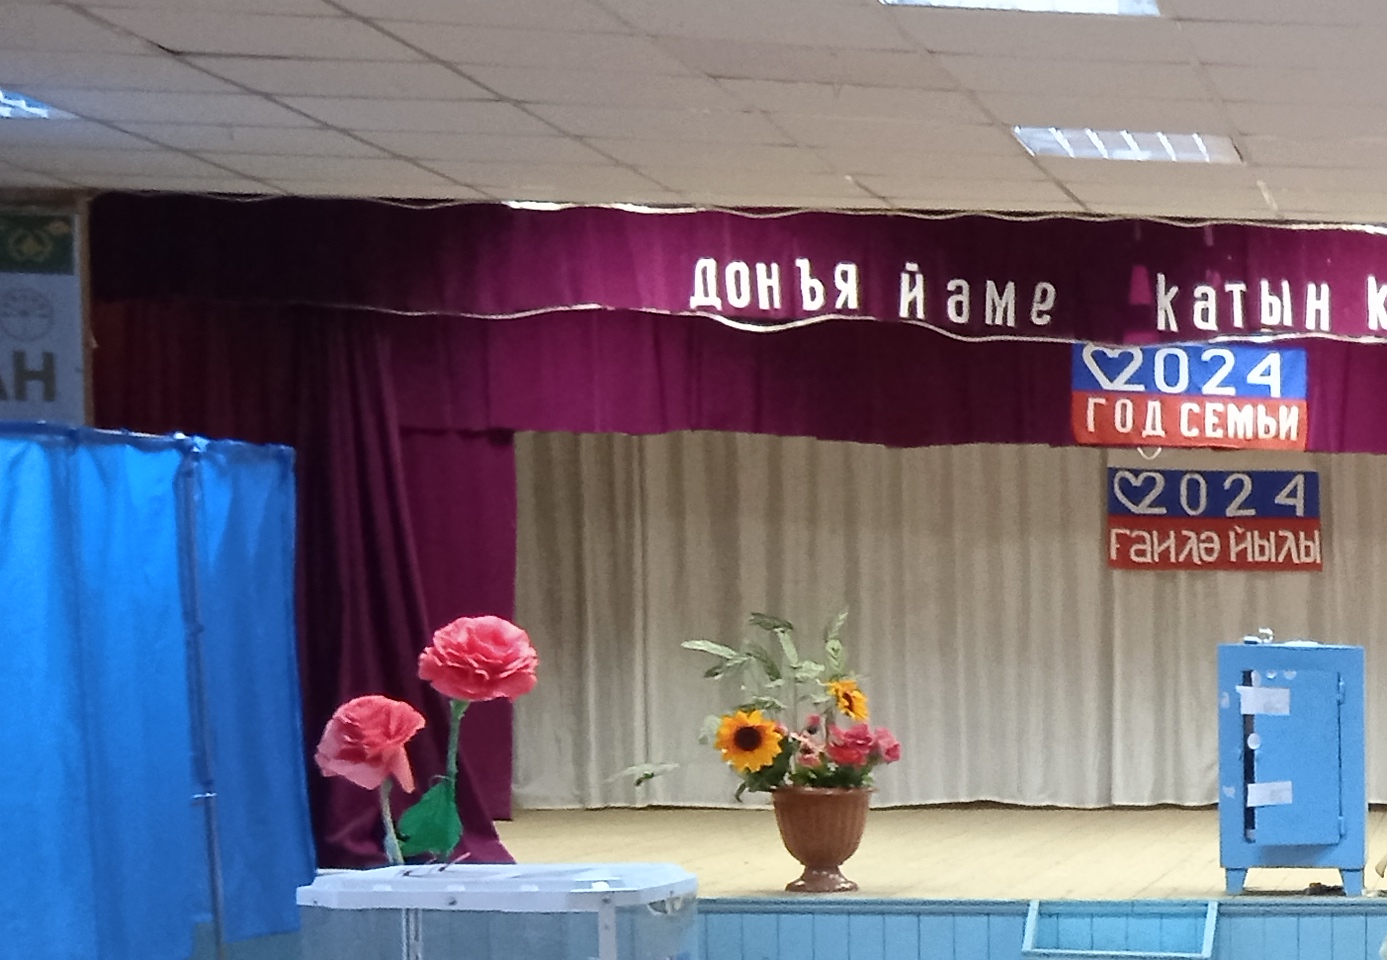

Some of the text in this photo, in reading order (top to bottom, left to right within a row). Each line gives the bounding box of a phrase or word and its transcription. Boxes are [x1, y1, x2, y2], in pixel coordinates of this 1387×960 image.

[1103, 346, 1282, 398] 2024
[1086, 397, 1300, 441] ГОД СЕМЬИ
[1132, 471, 1305, 518] 2024
